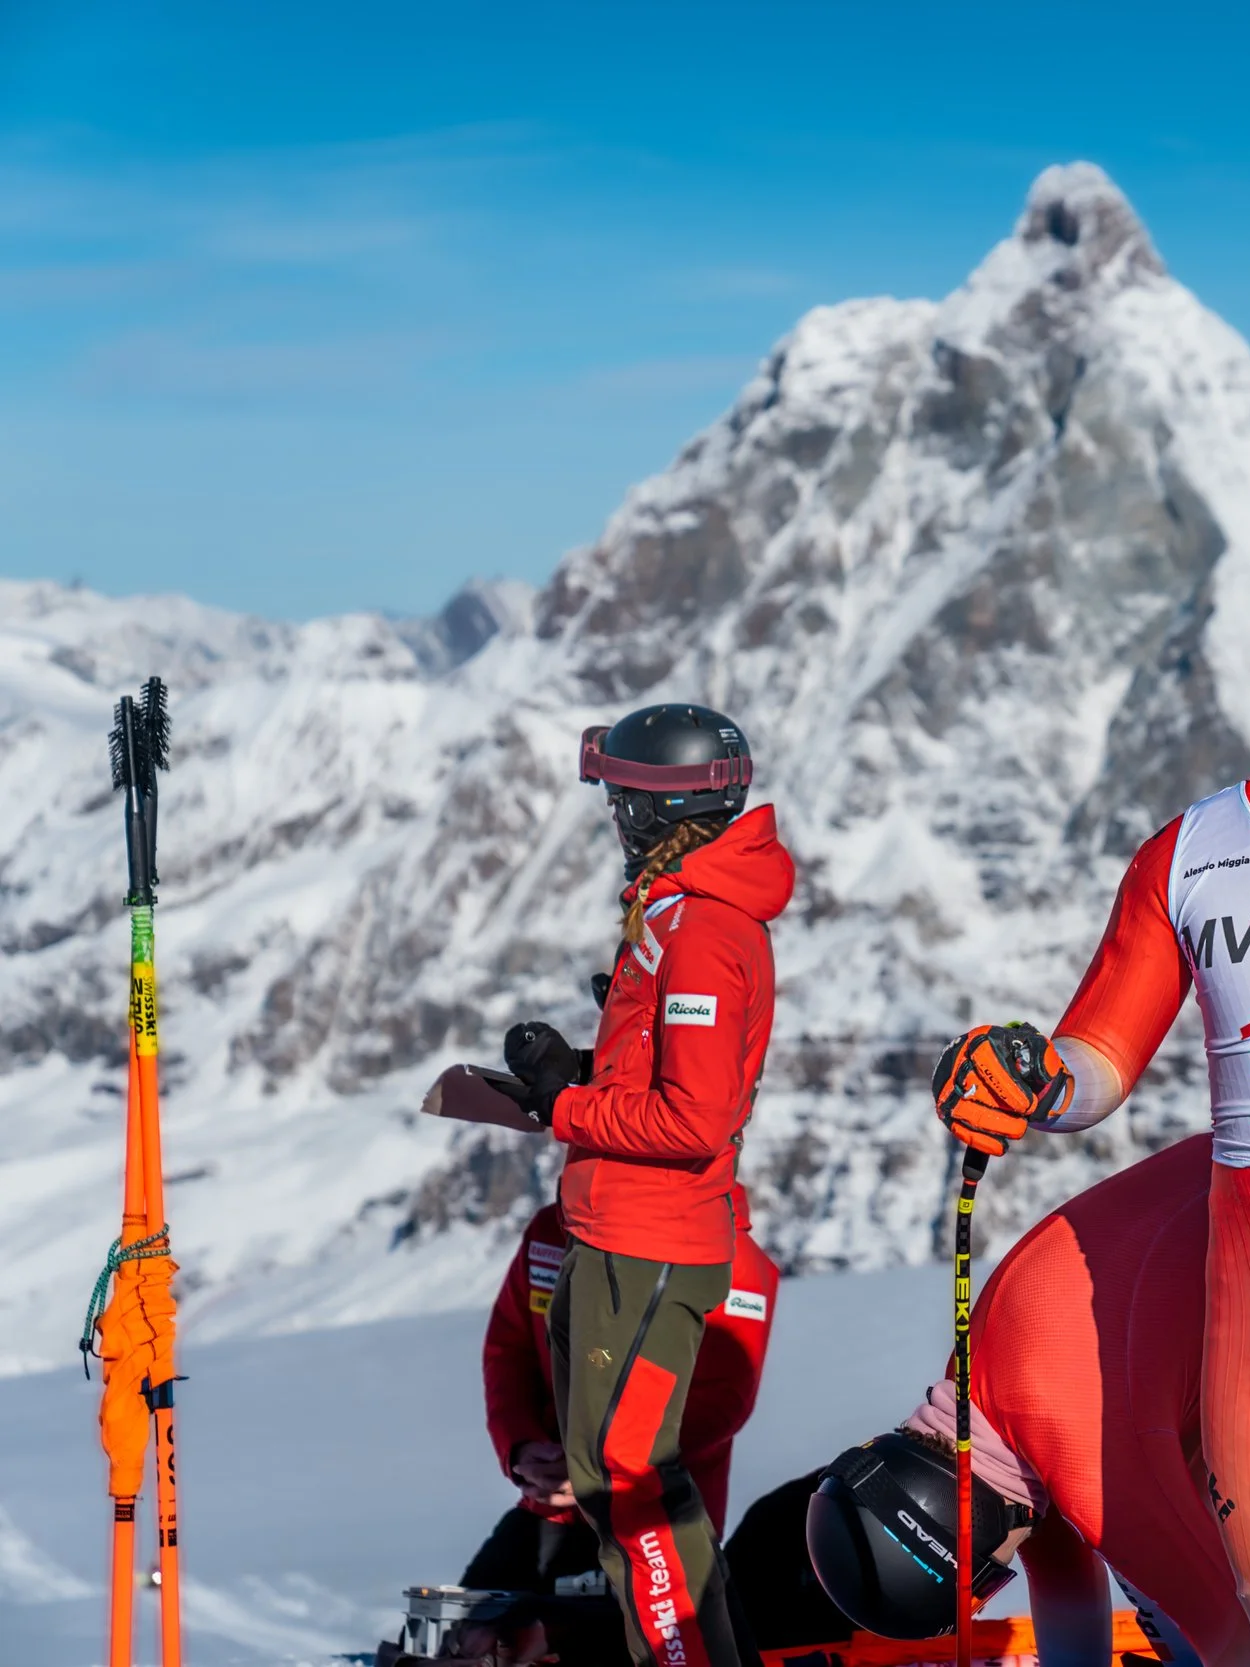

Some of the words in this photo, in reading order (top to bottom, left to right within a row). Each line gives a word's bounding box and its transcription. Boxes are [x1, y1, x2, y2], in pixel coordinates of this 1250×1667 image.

[1183, 862, 1215, 879] Alessio
[668, 1002, 711, 1016] Ricola
[955, 1253, 970, 1331] LEKI
[639, 1531, 672, 1597] team
[897, 1509, 958, 1569] HEAD
